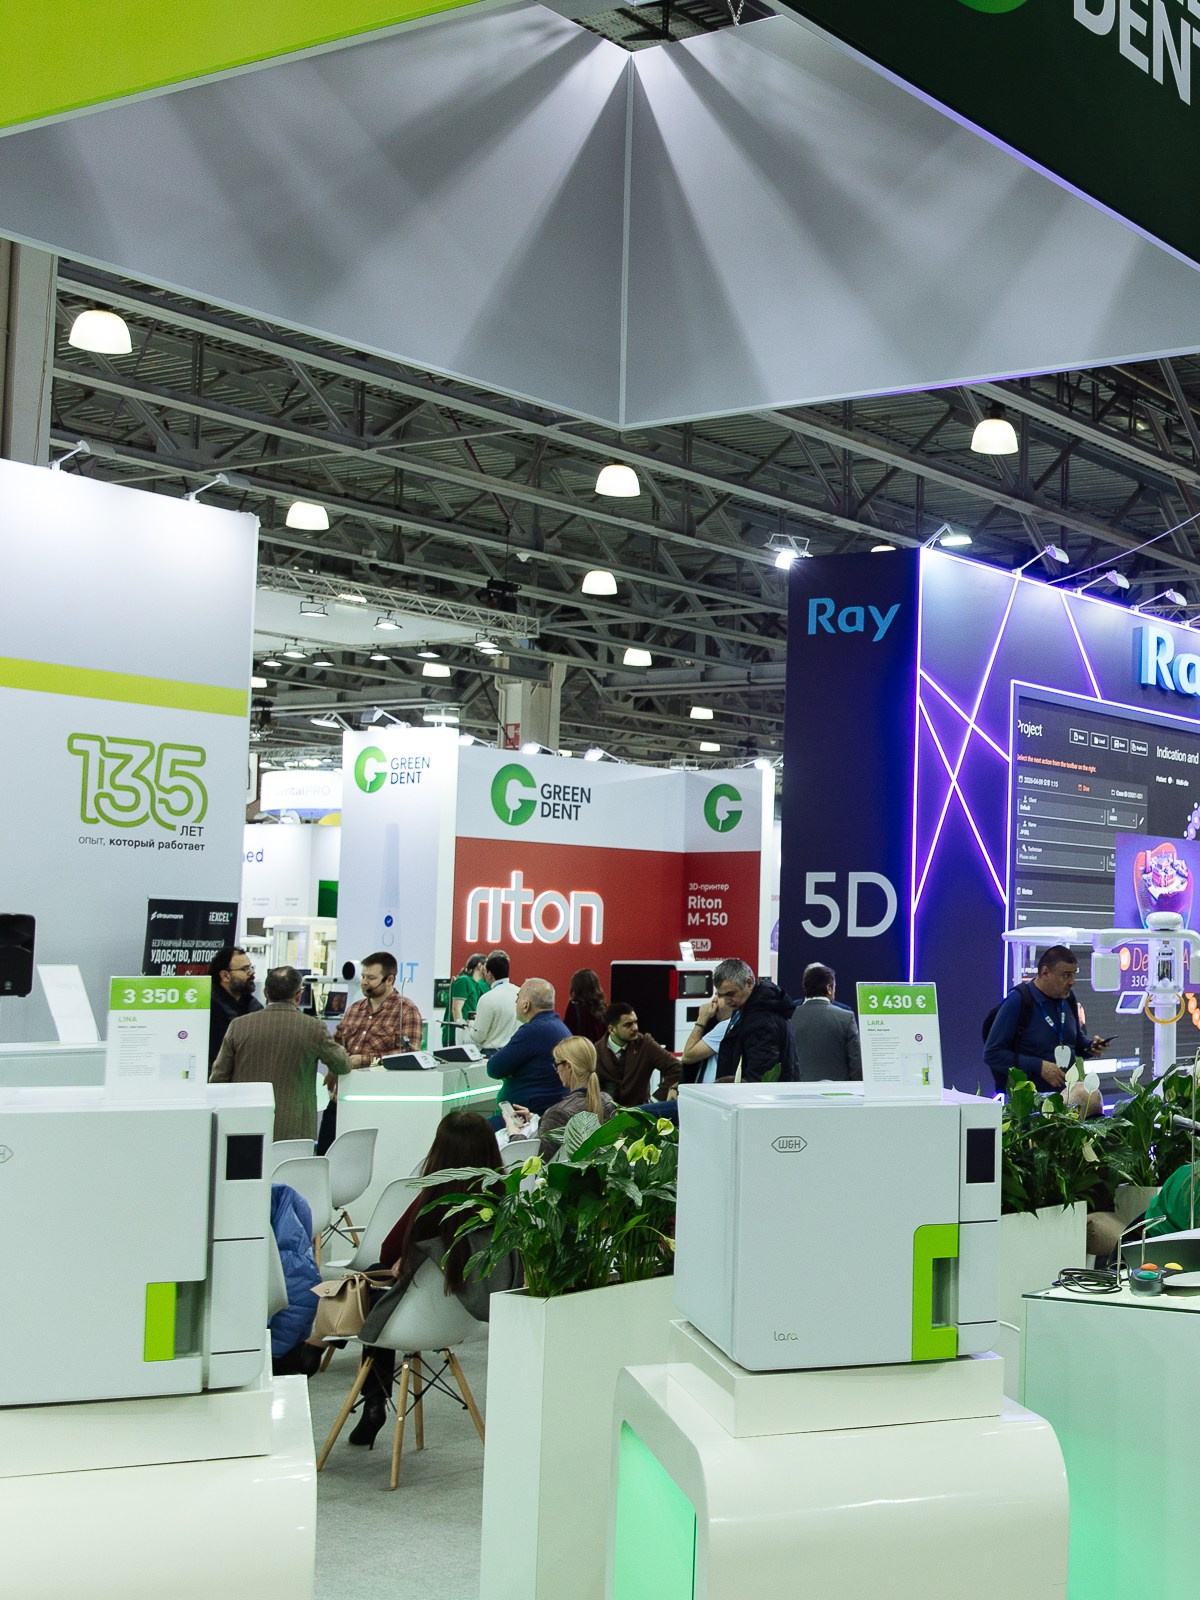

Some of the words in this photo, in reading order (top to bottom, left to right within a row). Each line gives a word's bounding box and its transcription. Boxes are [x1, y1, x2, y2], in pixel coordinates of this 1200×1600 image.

[807, 598, 901, 642] Ray
[1156, 745, 1187, 763] Indication
[1187, 751, 1200, 765] and
[390, 757, 431, 770] GREEN
[67, 733, 208, 831] 135
[390, 771, 423, 784] DENT
[540, 783, 592, 804] GREEN
[540, 802, 582, 821] DENT
[180, 826, 204, 837] ЛЕТ
[109, 838, 155, 849] который
[158, 840, 205, 851] работает
[688, 882, 730, 893] 3D-принтер
[465, 869, 604, 945] riton
[687, 895, 723, 910] Riton
[801, 871, 898, 938] 5D
[687, 912, 728, 926] M-150
[691, 940, 709, 950] SLM
[151, 949, 190, 964] УДОБСТВО,
[123, 989, 136, 1004] 3
[141, 989, 180, 1004] 350
[184, 988, 198, 1004] €
[868, 995, 878, 1009] 3
[883, 995, 912, 1009] 430
[916, 995, 926, 1009] €
[778, 1139, 801, 1149] W&H
